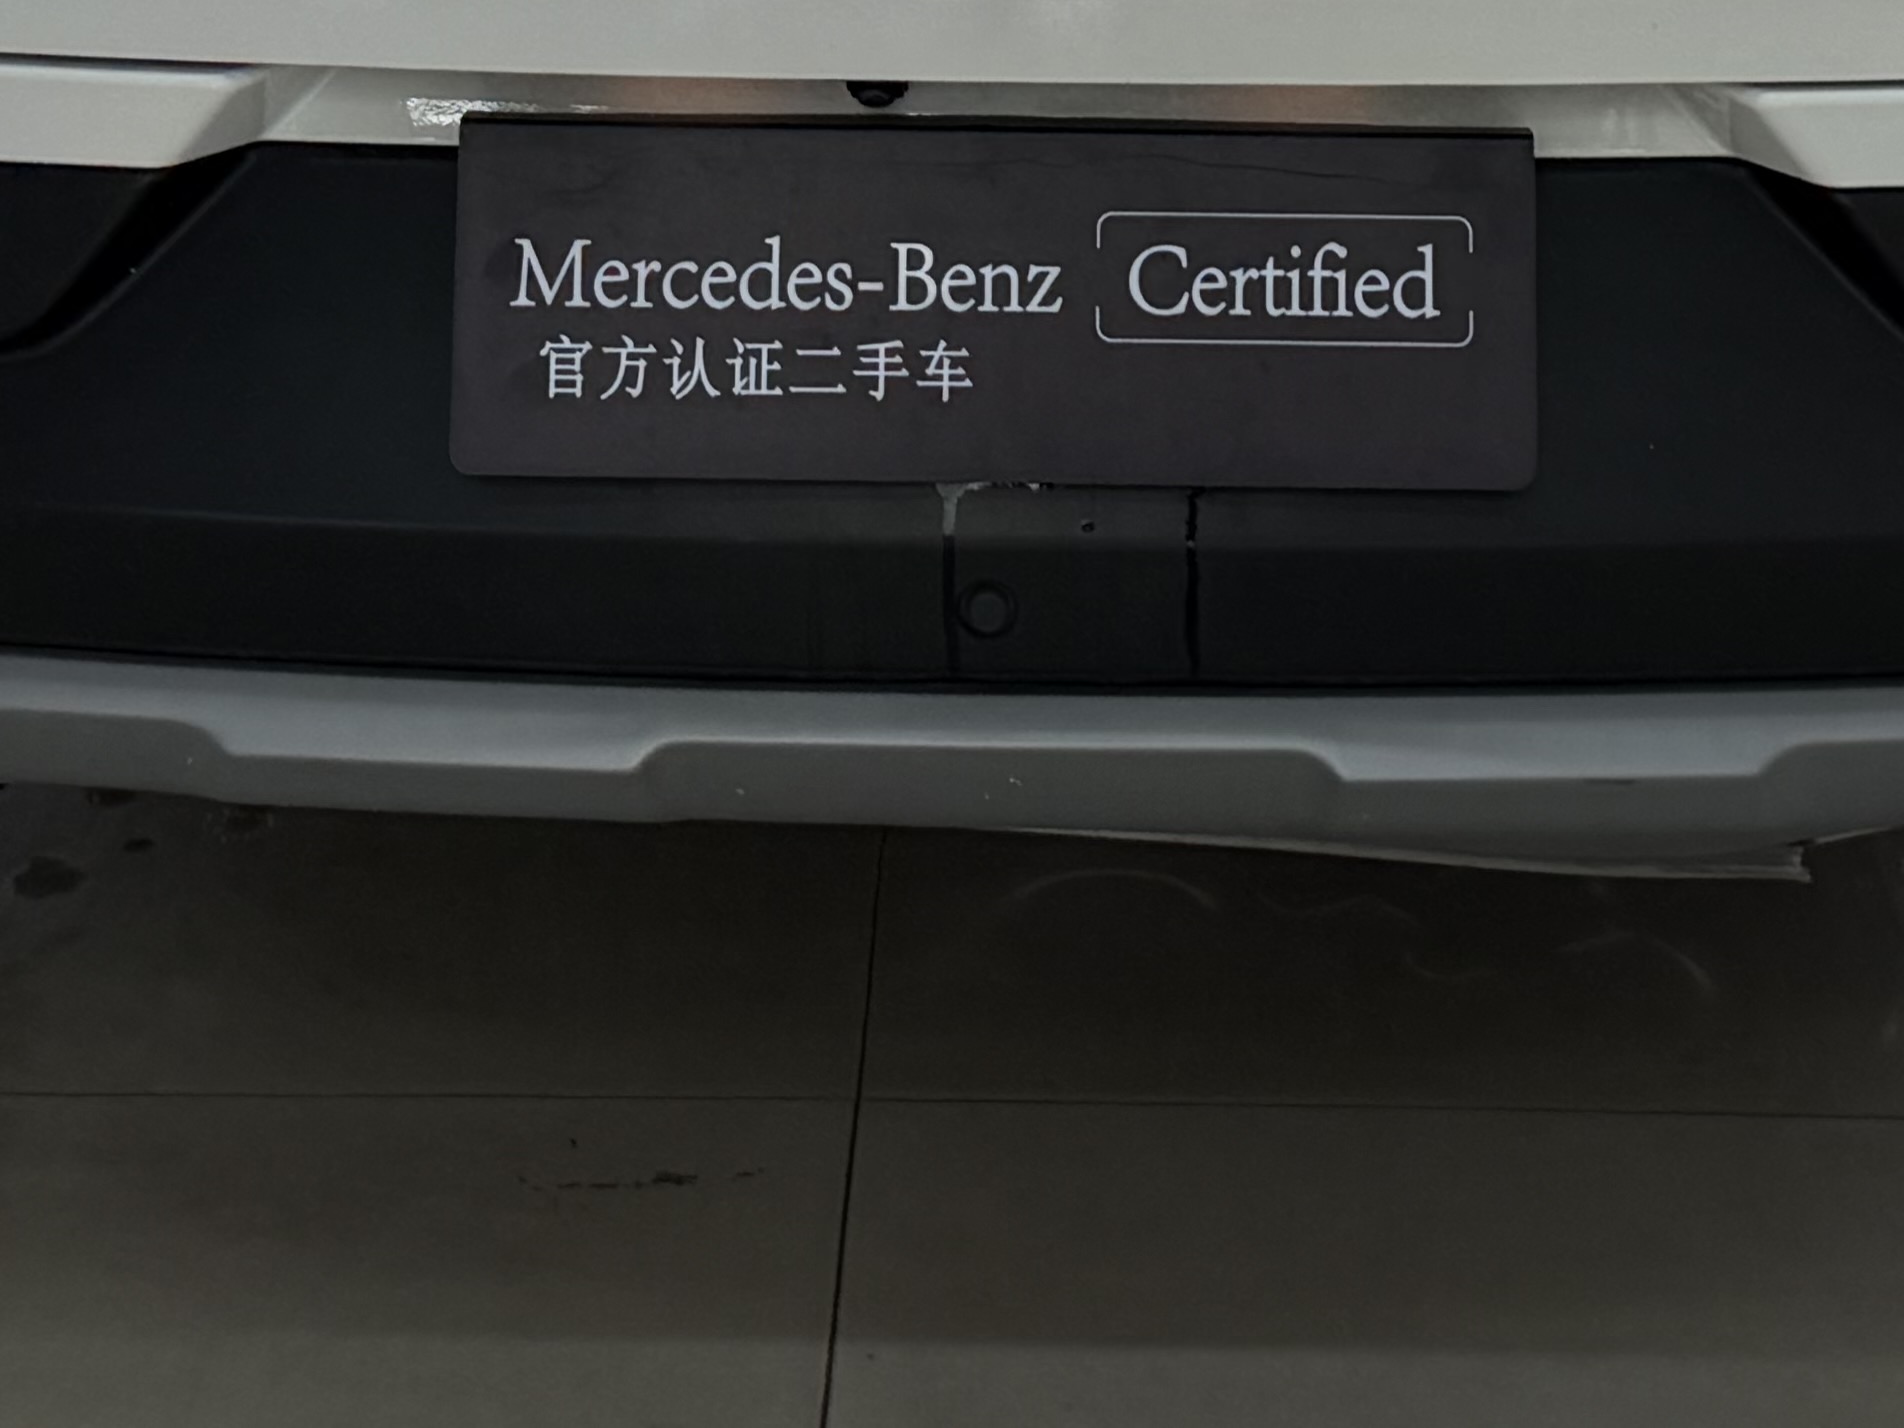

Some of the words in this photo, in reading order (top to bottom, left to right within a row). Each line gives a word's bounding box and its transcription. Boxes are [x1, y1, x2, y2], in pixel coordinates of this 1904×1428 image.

[507, 235, 1064, 314] Mercedes-Benz
[1126, 241, 1442, 322] Certified
[538, 333, 974, 403] 官方认证二手车
